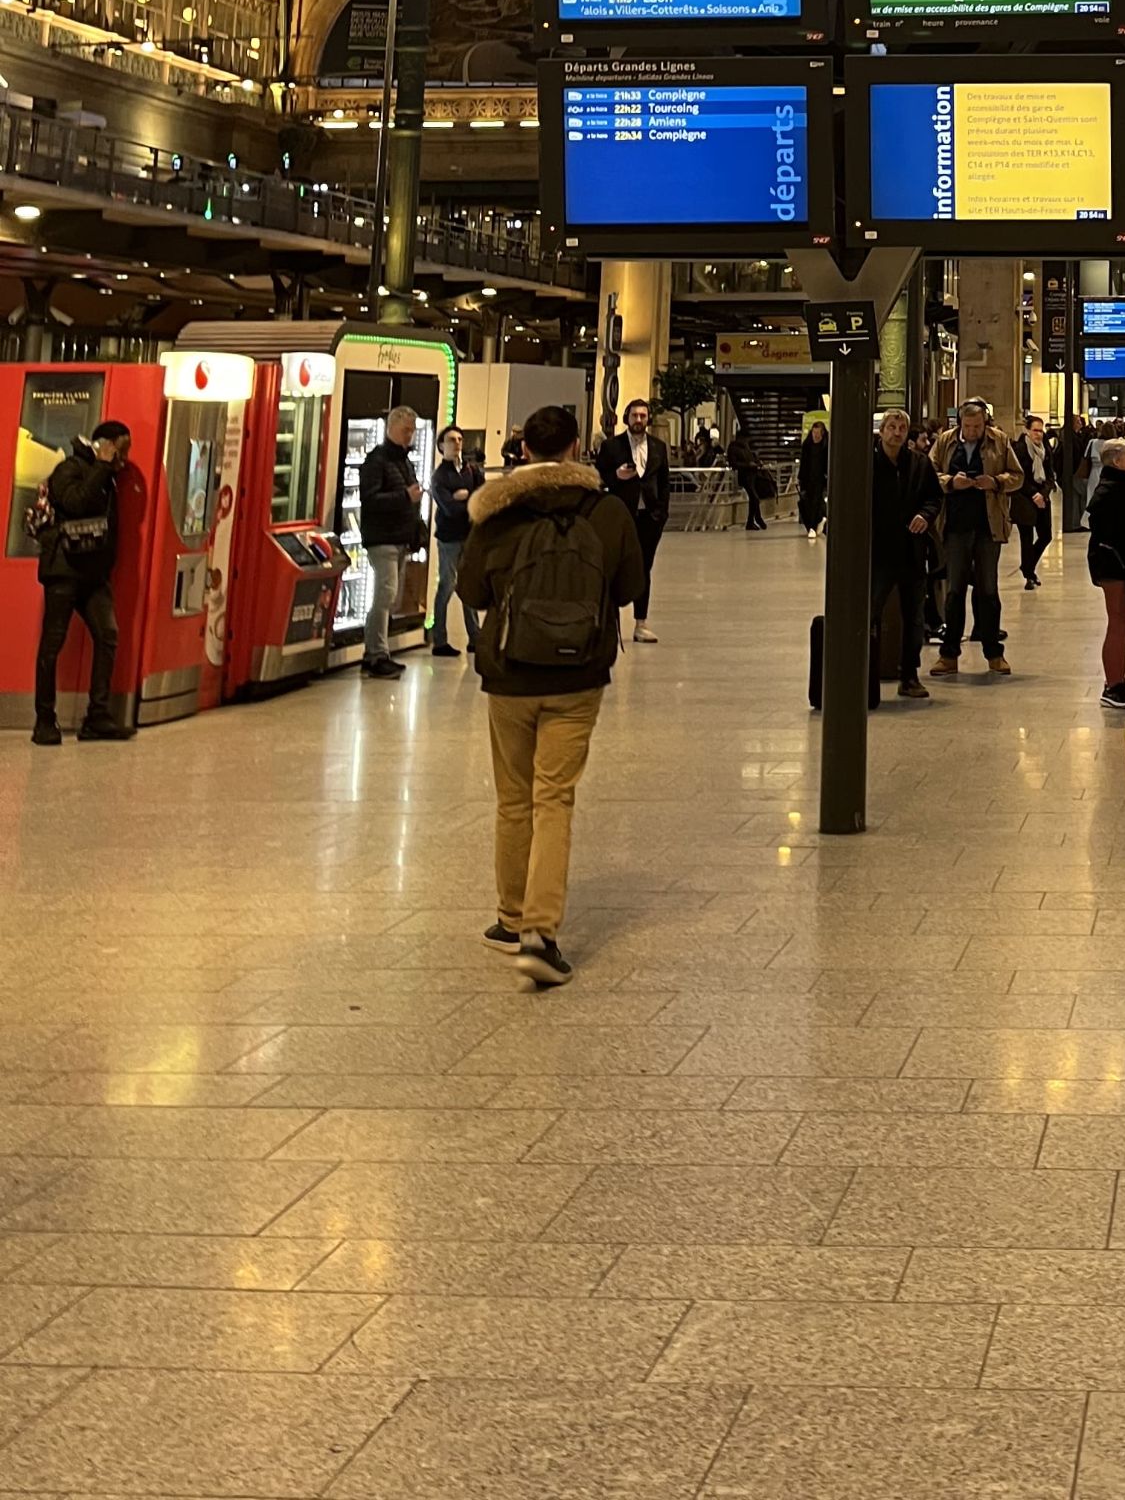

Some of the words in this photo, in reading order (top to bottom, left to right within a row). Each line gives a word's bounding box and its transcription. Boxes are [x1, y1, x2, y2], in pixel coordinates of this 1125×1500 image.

[615, 4, 699, 16] Villers-Cotterêts
[706, 4, 750, 14] Soissons
[882, 5, 893, 14] de
[894, 5, 913, 13] mise
[925, 4, 974, 13] accessibilité
[975, 4, 989, 13] des
[990, 4, 1011, 14] gares
[1013, 3, 1023, 12] de
[1024, 2, 1069, 13] Compiègne
[873, 20, 891, 28] train
[922, 19, 944, 27] heure
[955, 19, 998, 28] provenance
[1094, 16, 1110, 24] voie
[564, 61, 609, 74] Départs
[611, 61, 657, 72] Grandes
[660, 60, 696, 73] Lignes
[648, 89, 706, 102] Compiègne
[967, 92, 982, 101] Des
[984, 93, 1013, 101] travaux
[648, 102, 699, 115] Tourcoing
[967, 104, 1014, 112] accessibilité
[1016, 104, 1030, 112] des
[1032, 105, 1053, 113] gares
[648, 116, 687, 127] Amiens
[967, 115, 1011, 124] Compiègne
[1023, 115, 1078, 123] Saint-Quentin
[648, 129, 707, 142] Compiègne
[1023, 128, 1058, 136] plusieurs
[1074, 138, 1084, 146] La
[931, 86, 952, 220] information
[967, 150, 1009, 158] circulation
[1010, 150, 1024, 158] des
[769, 104, 802, 221] départs
[967, 161, 982, 169] C14
[1025, 161, 1060, 169] modifiée
[851, 316, 863, 331] P
